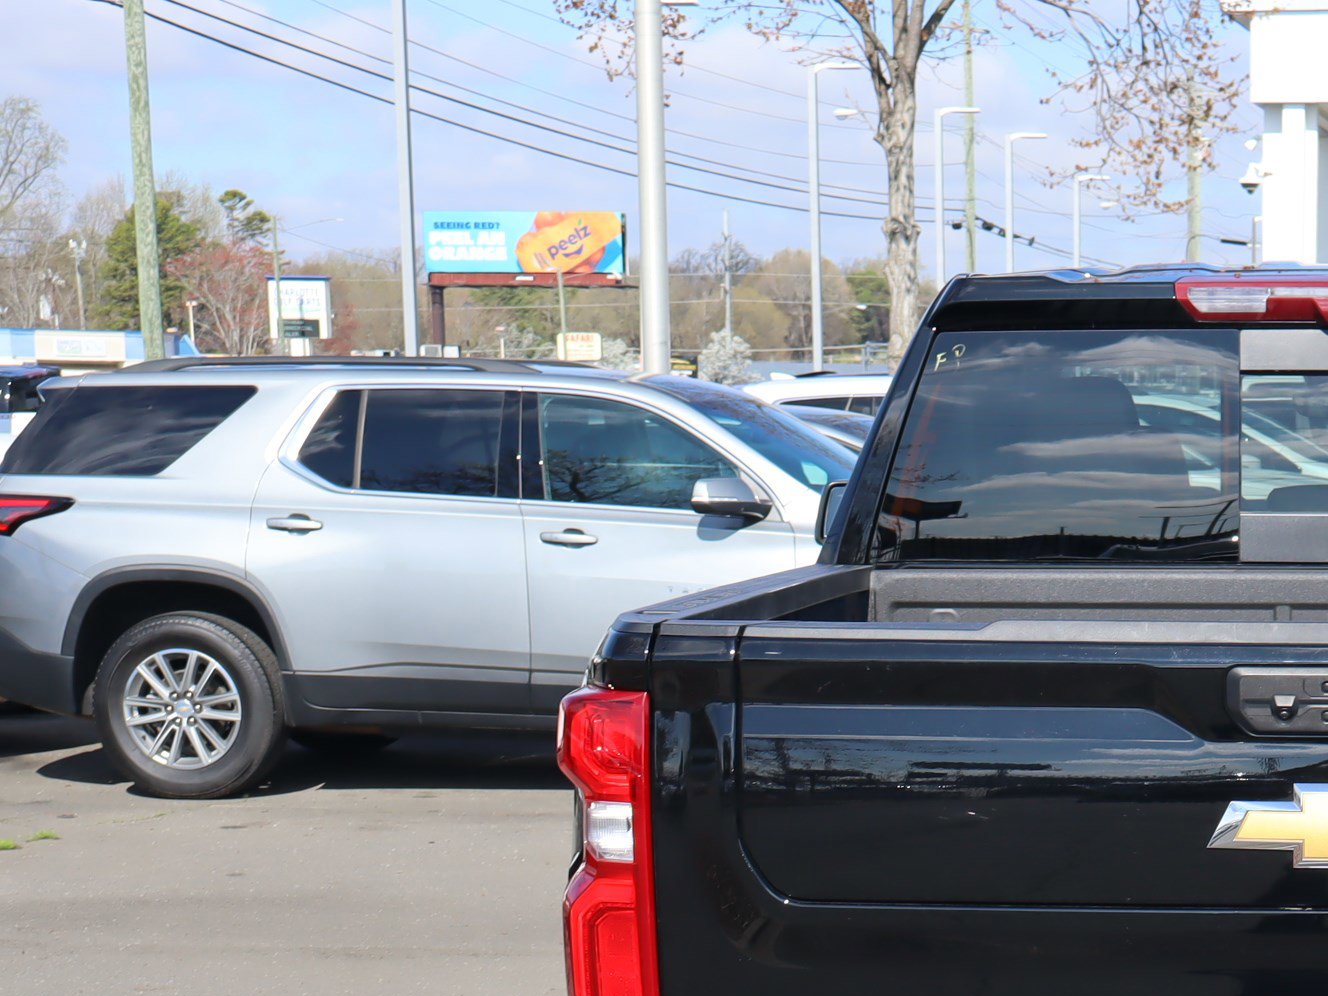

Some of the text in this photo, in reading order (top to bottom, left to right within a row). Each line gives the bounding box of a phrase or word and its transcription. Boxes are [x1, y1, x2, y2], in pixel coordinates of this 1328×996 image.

[433, 221, 501, 230] SEEING RED?
[429, 231, 474, 246] PEEL
[428, 246, 508, 261] ORANGE
